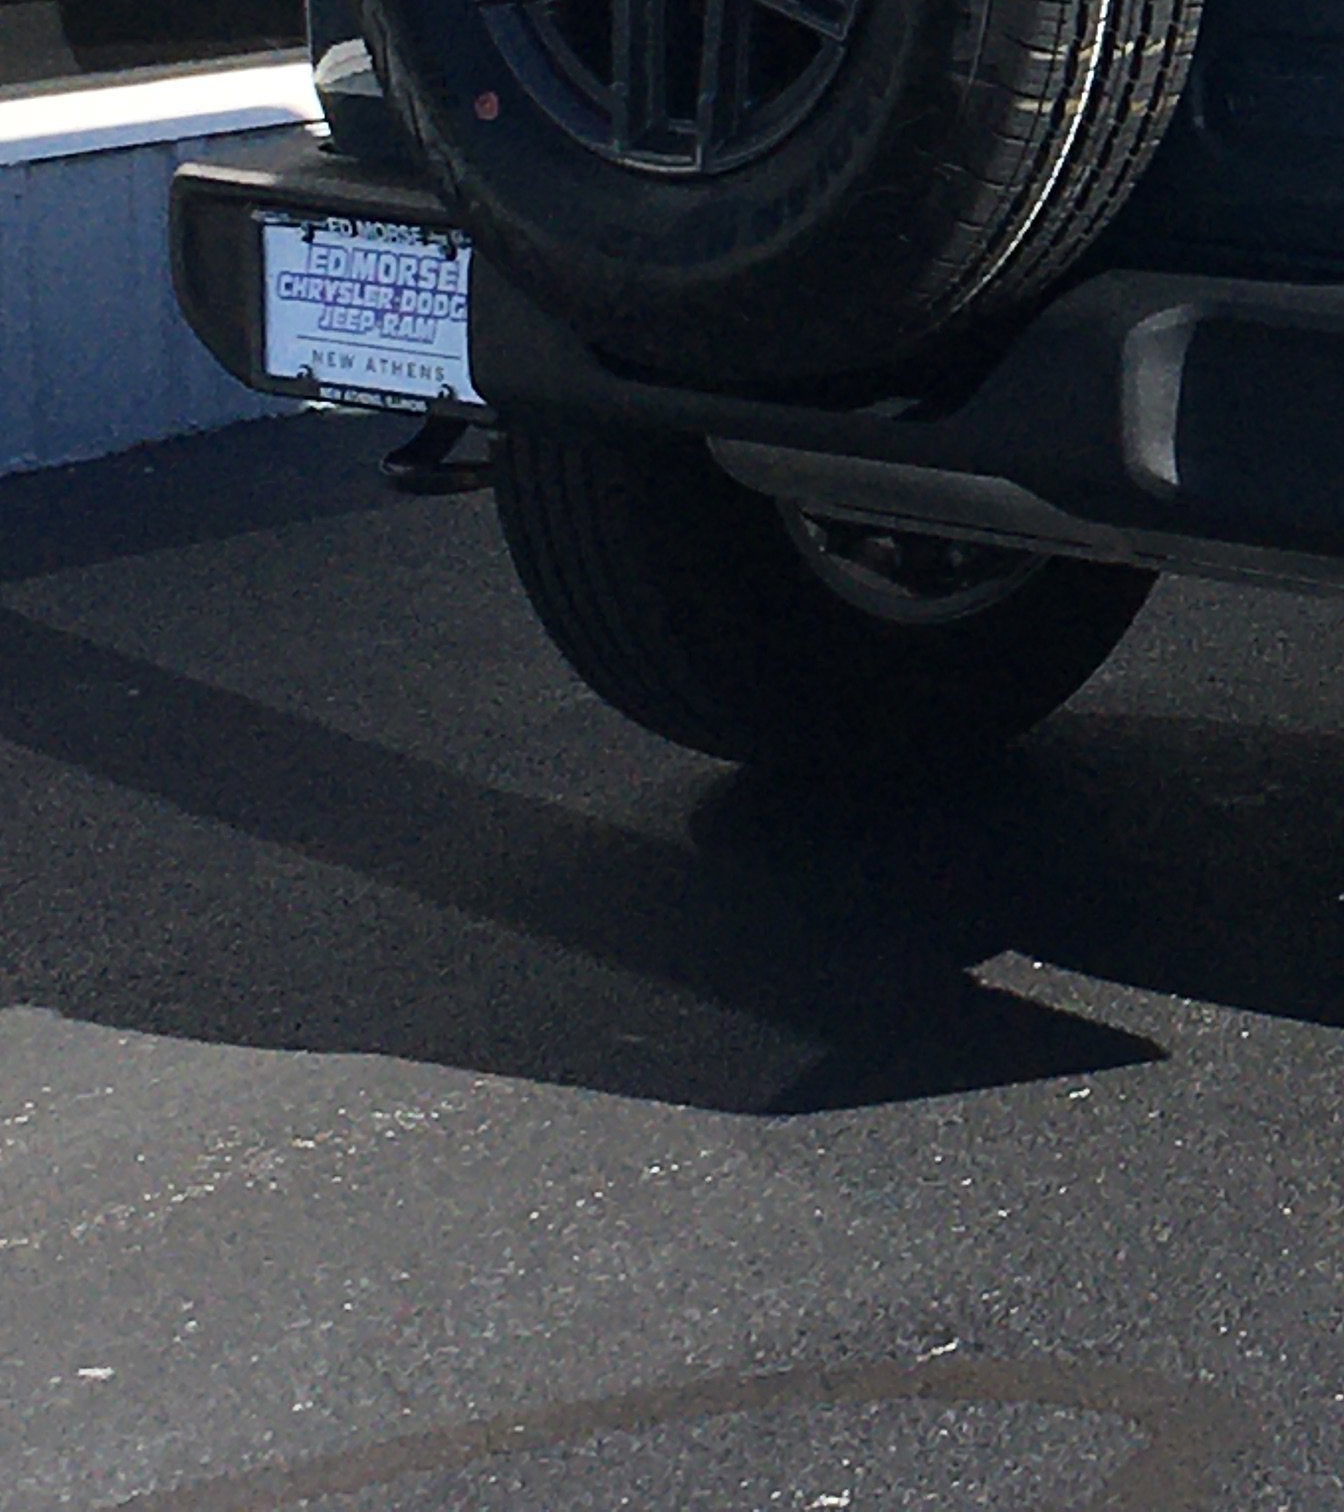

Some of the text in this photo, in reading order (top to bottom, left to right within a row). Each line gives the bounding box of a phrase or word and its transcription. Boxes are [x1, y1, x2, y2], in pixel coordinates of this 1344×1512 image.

[309, 243, 460, 294] ED MORSE
[400, 288, 467, 322] DODG
[311, 349, 446, 383] NEW ATHENS
